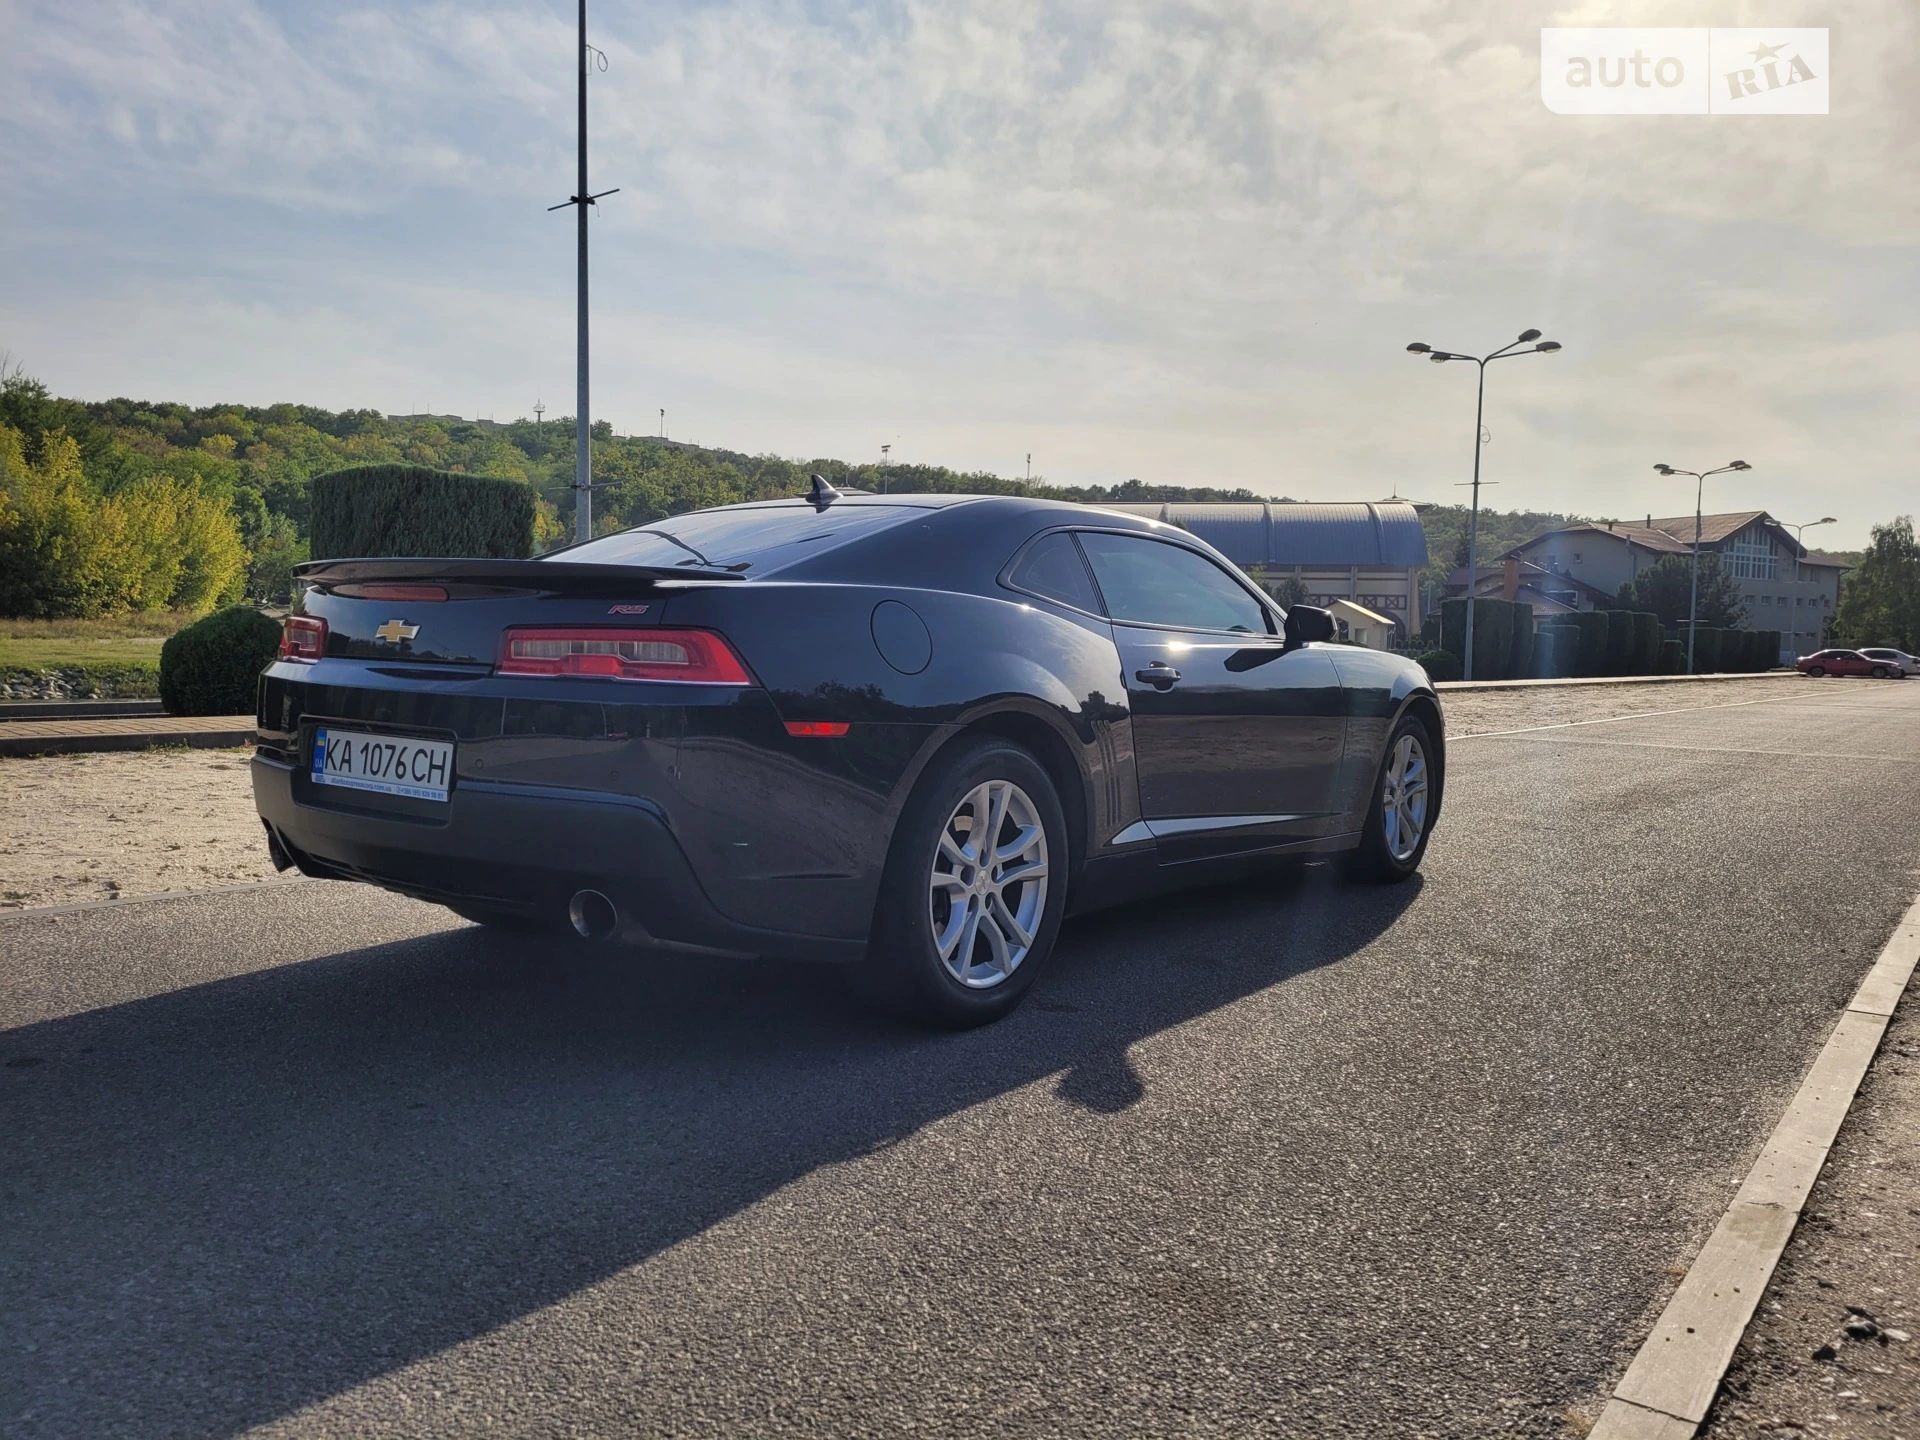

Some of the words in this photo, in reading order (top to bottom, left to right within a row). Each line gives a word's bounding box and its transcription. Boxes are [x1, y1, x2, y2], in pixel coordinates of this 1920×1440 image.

[607, 604, 650, 615] RS
[315, 758, 323, 768] UA
[324, 737, 352, 773] KA
[360, 742, 408, 780] 1076
[411, 748, 448, 786] CH
